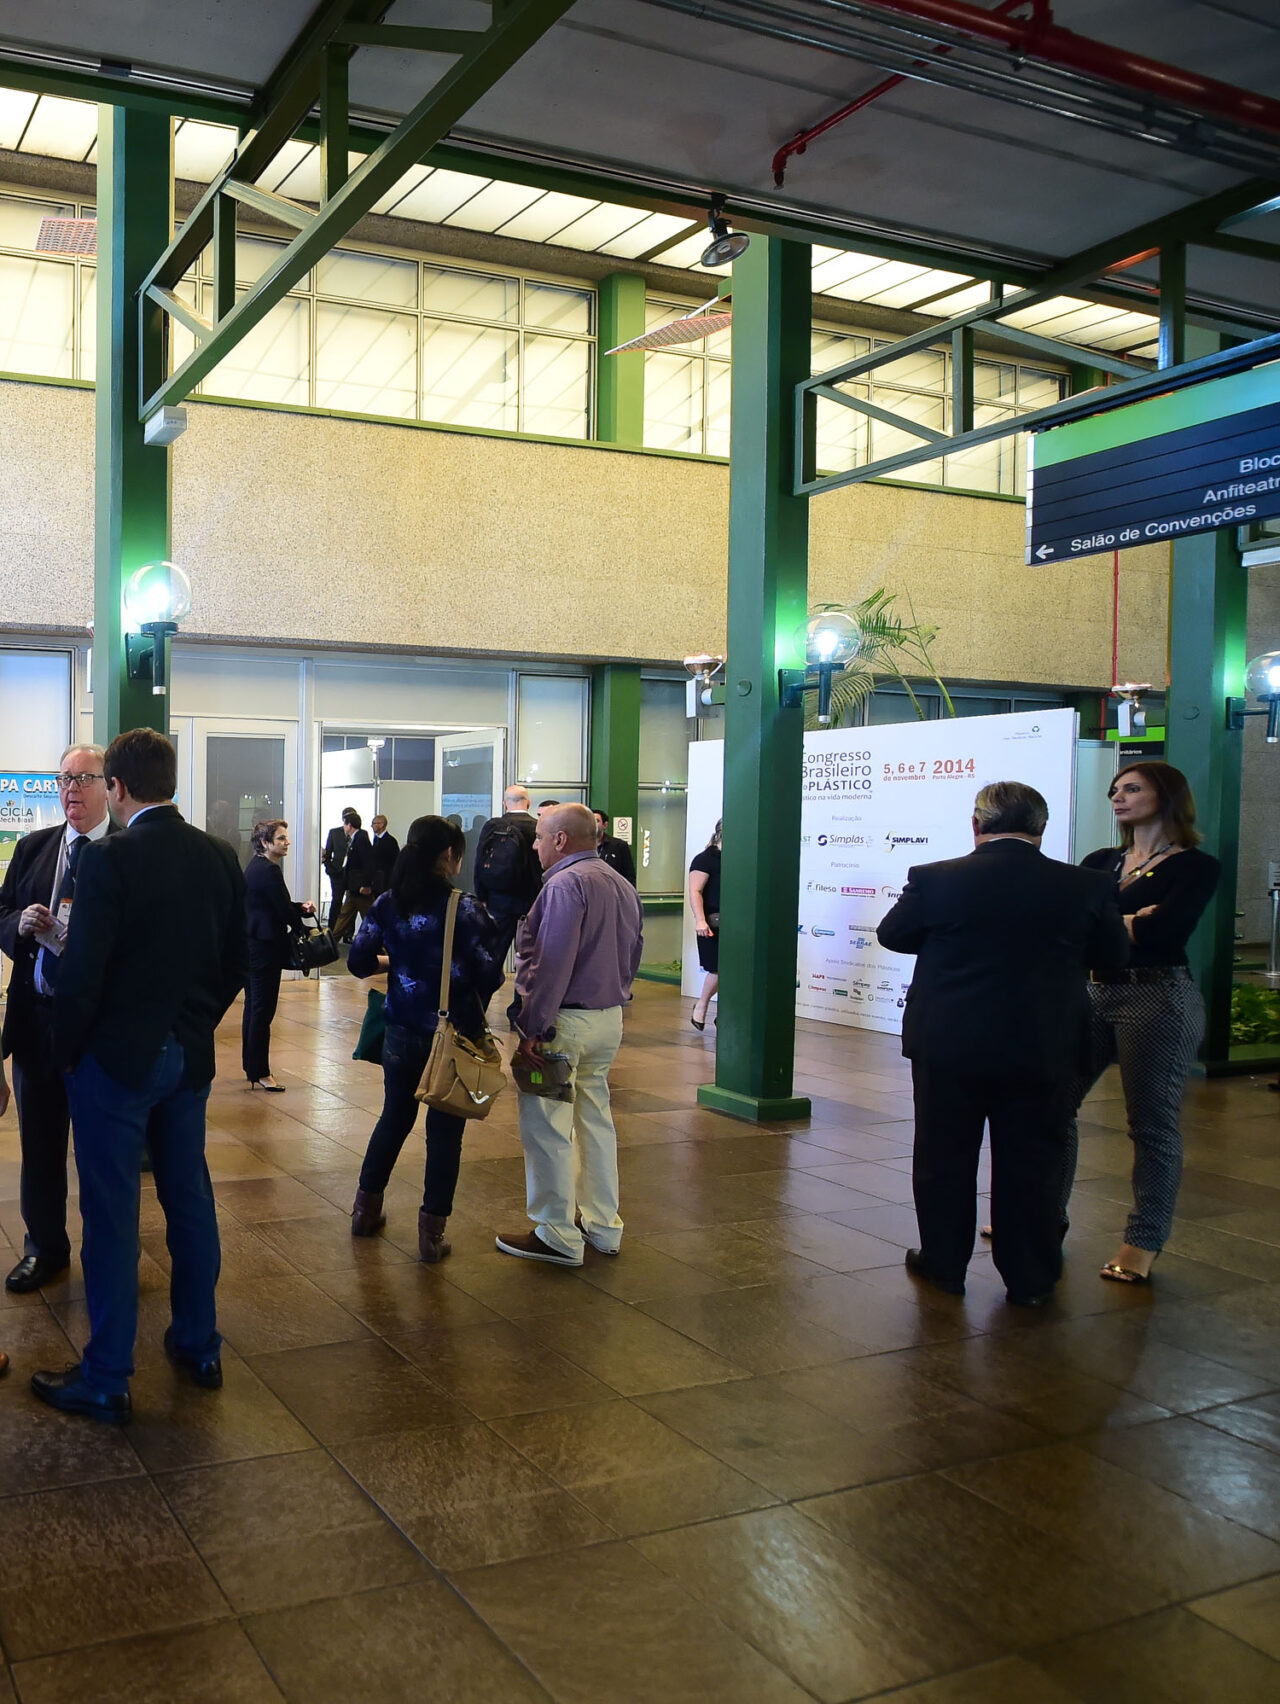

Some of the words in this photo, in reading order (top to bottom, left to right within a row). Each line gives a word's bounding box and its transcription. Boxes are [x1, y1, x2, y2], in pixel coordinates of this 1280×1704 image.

[1239, 455, 1280, 473] Bloc
[1203, 476, 1280, 504] Anfiteatr
[1070, 533, 1116, 552] Salão
[1120, 527, 1140, 541] de
[1145, 504, 1257, 536] Convenções
[883, 763, 895, 776] 5,
[898, 763, 906, 774] 6
[908, 764, 916, 773] e
[919, 761, 926, 773] 7
[933, 758, 976, 774] 2014
[23, 779, 60, 794] CART
[809, 779, 872, 791] PLÁSTICO
[842, 792, 872, 801] moderna
[892, 836, 929, 844] SIMPLAVI
